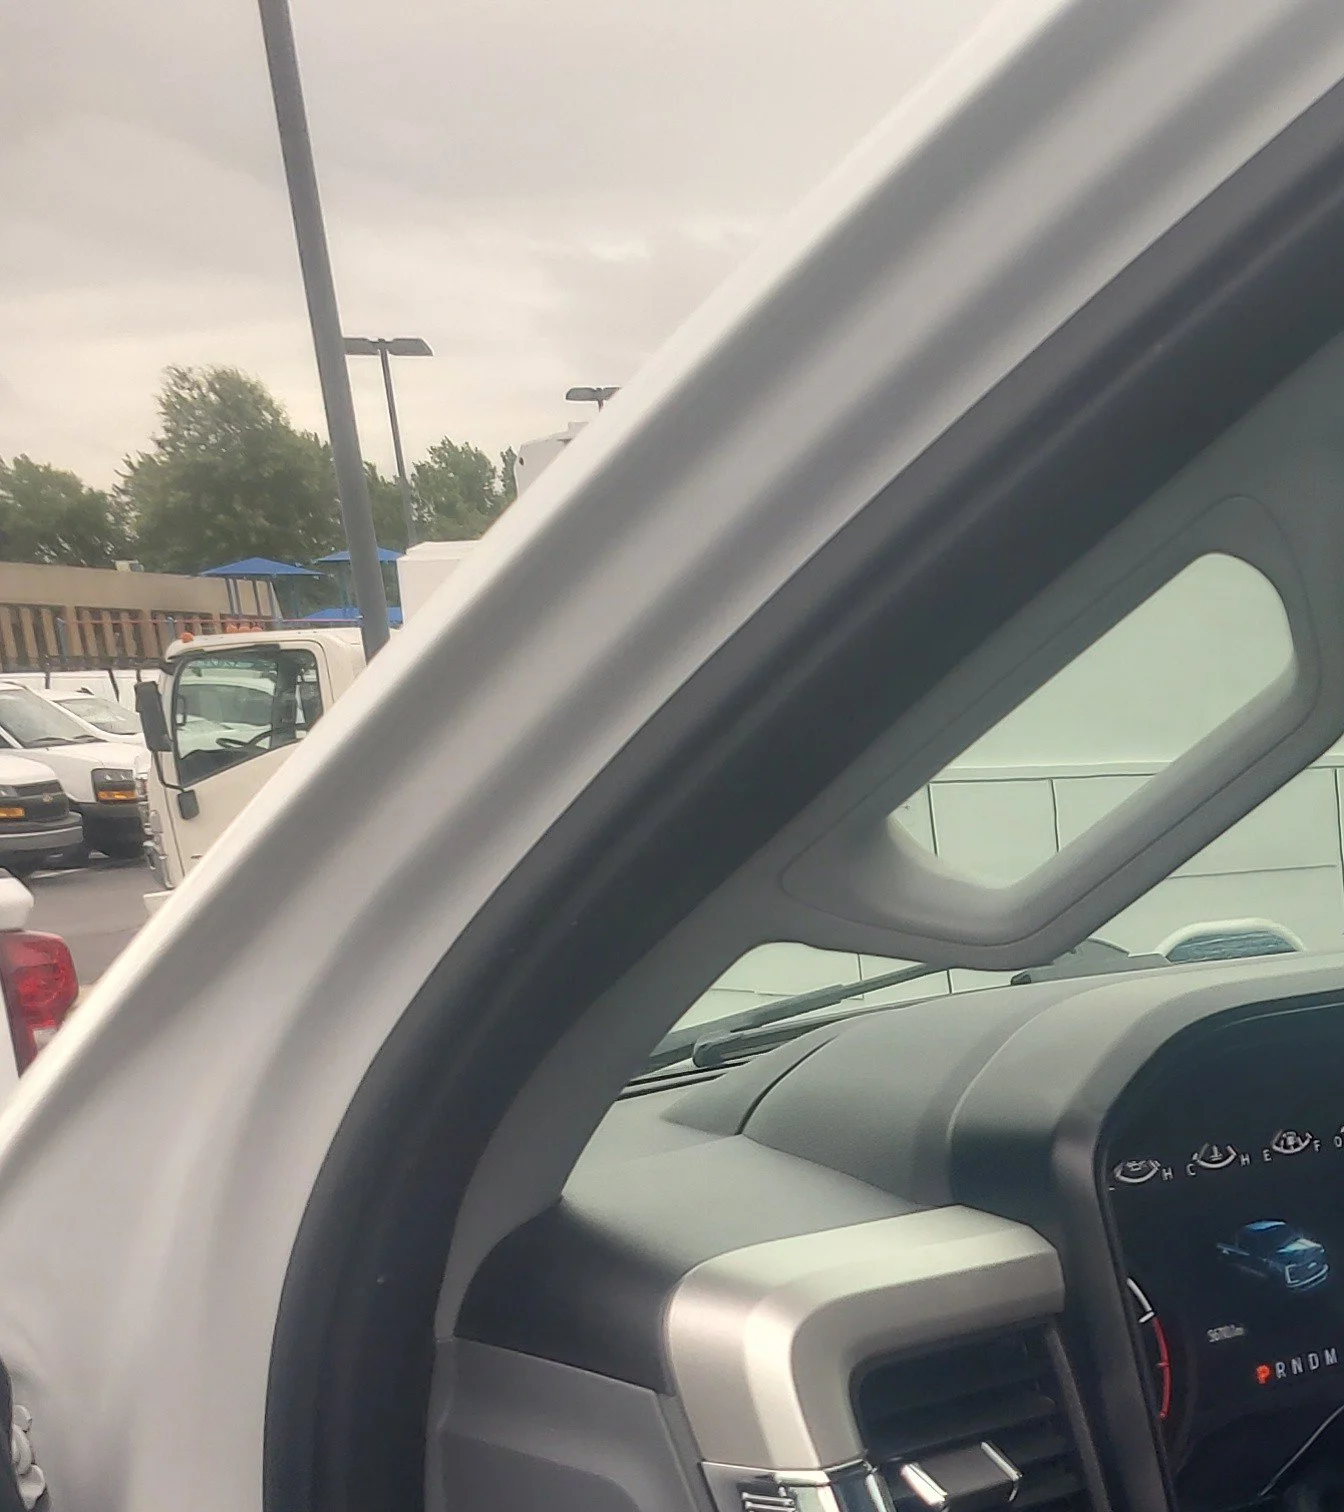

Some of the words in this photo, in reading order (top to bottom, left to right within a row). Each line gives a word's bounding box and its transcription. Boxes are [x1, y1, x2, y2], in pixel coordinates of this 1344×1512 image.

[1239, 1154, 1251, 1167] H
[1262, 1149, 1273, 1162] E
[1160, 1167, 1174, 1181] H
[1186, 1163, 1197, 1177] C
[1256, 1364, 1270, 1384] P
[1275, 1361, 1287, 1379] R
[1291, 1356, 1304, 1375] N
[1307, 1353, 1320, 1371] D
[1324, 1348, 1338, 1366] M
